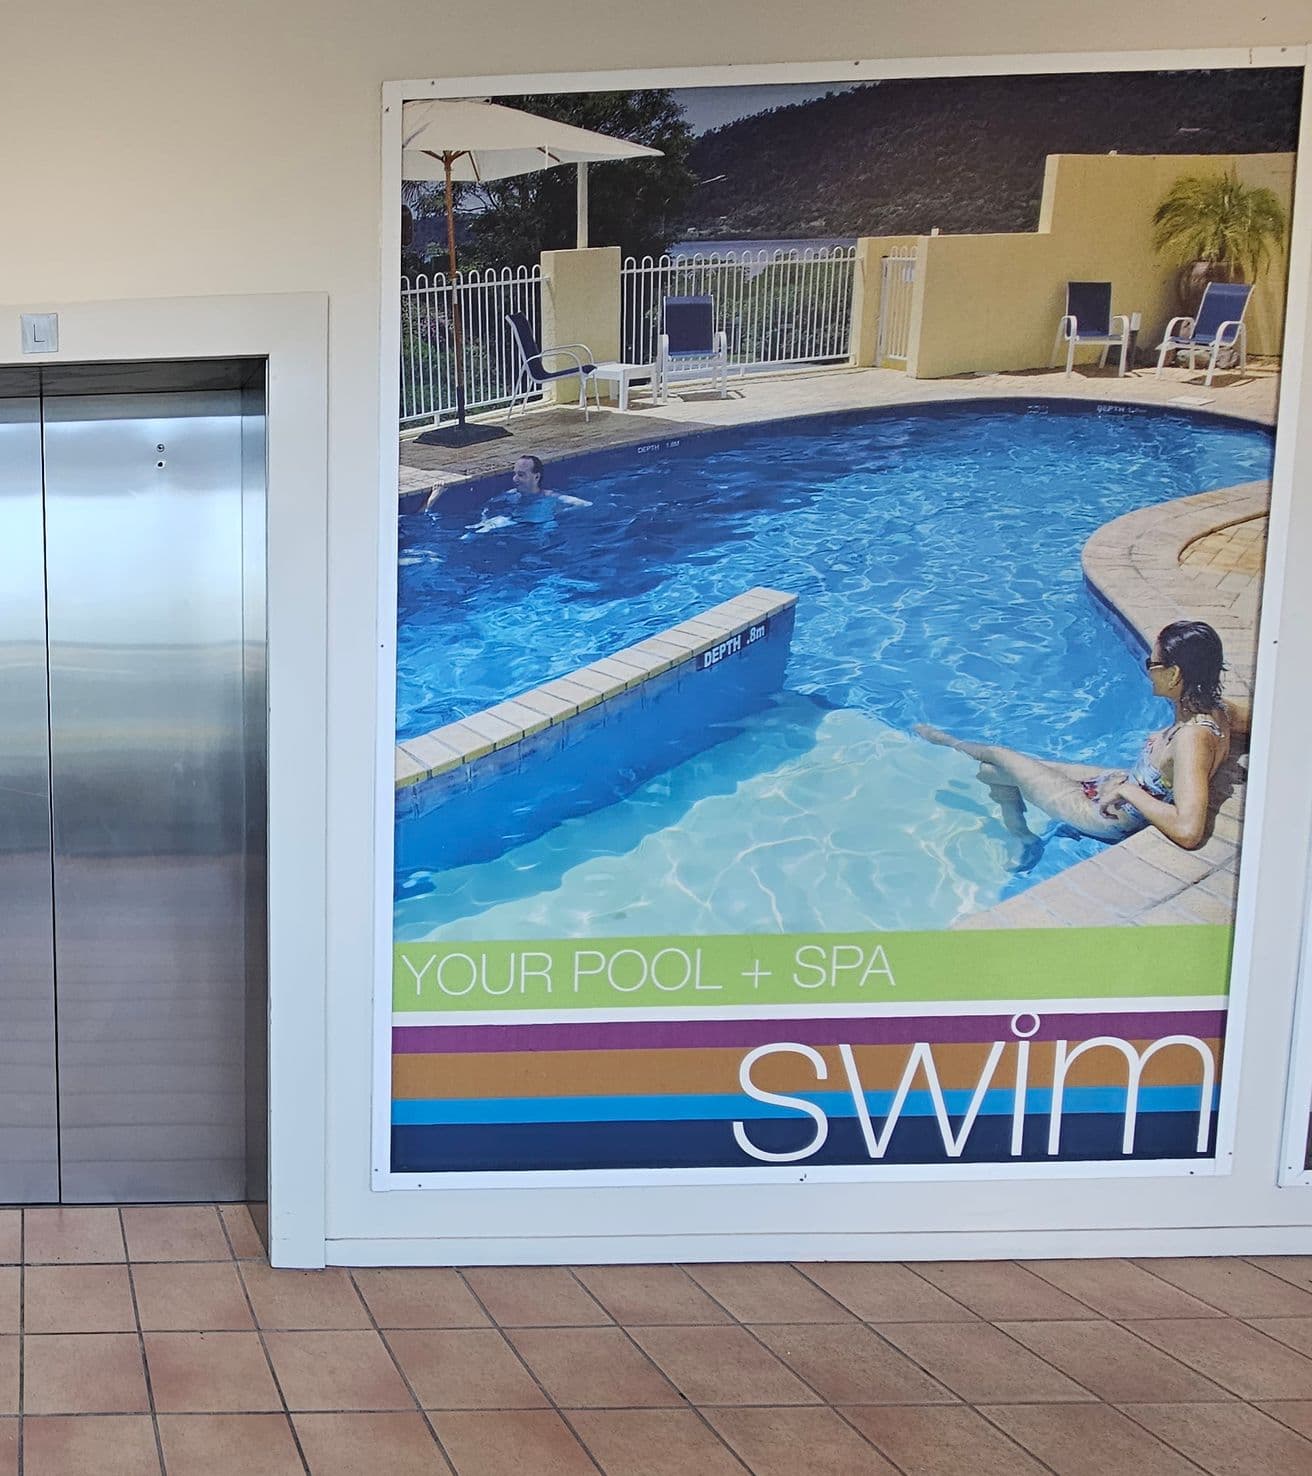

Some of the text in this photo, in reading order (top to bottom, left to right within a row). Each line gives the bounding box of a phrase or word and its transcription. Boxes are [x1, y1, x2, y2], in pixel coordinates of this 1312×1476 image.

[32, 323, 46, 343] L
[637, 444, 660, 454] DEPTH
[704, 625, 765, 668] DEPTH .8m
[401, 952, 553, 996] YOUR
[574, 948, 724, 993] POOL
[792, 944, 897, 989] SPA
[733, 1012, 1215, 1163] swim
